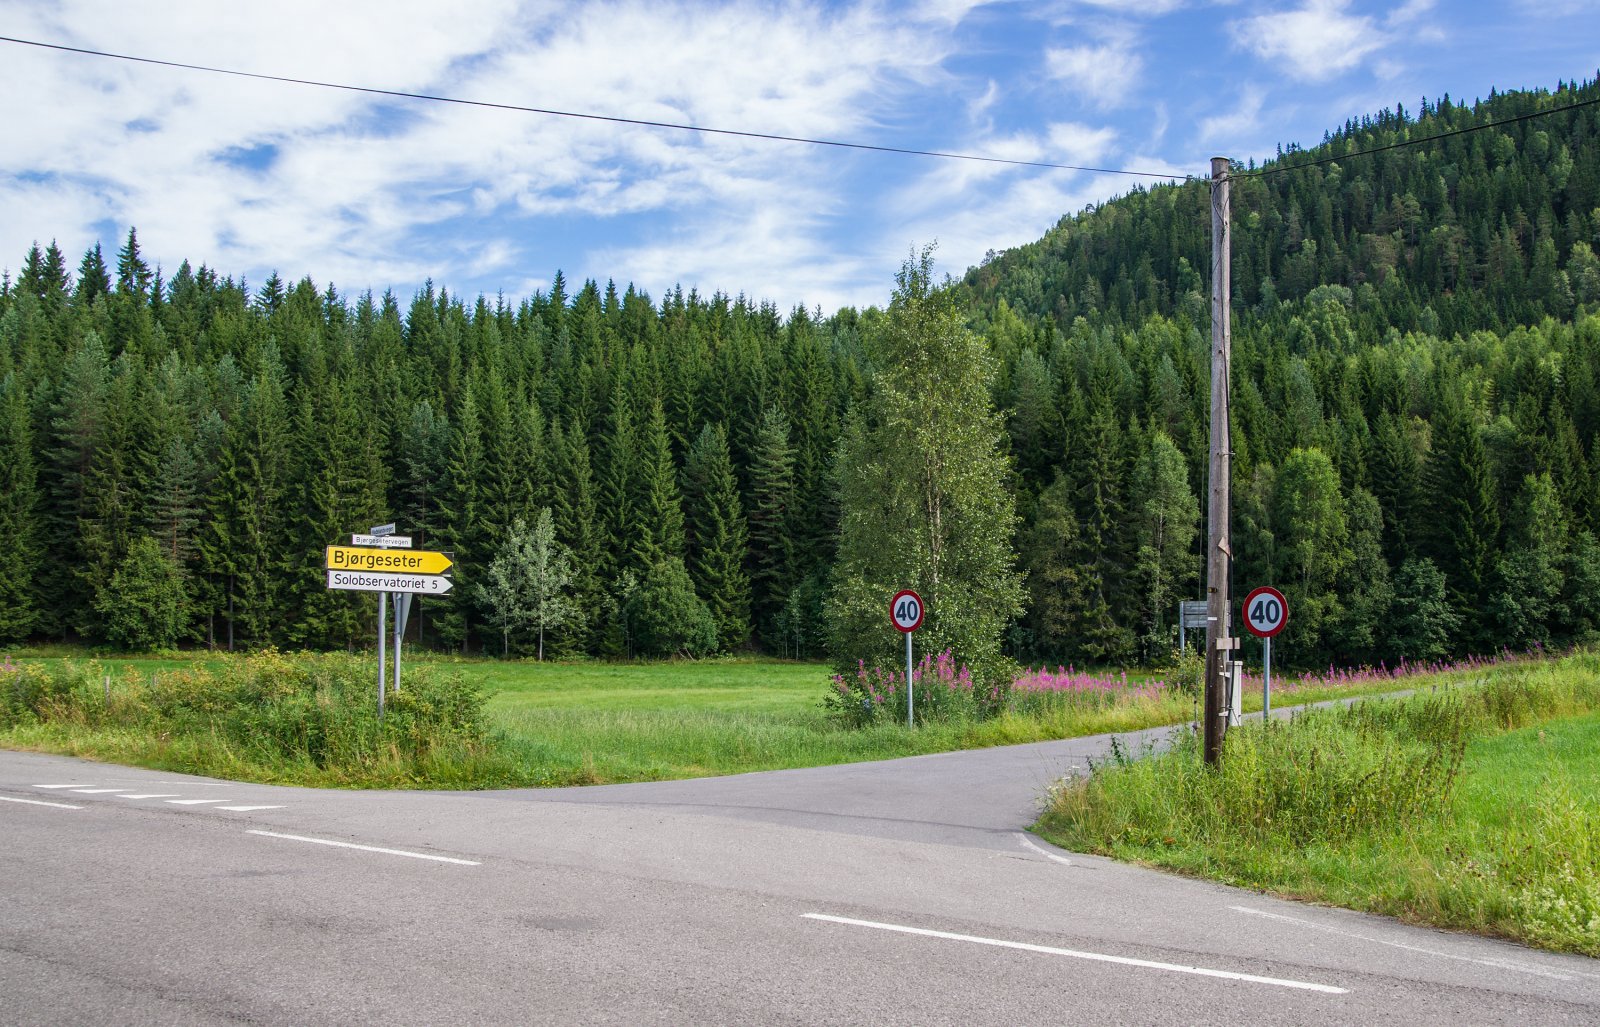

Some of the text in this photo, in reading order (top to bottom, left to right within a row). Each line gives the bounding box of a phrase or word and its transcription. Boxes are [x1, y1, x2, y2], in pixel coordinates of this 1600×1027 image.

[334, 550, 423, 568] Bjørgeseter
[334, 573, 438, 589] Solobservatoriet 5
[896, 601, 918, 621] 40
[1250, 600, 1280, 624] 40
